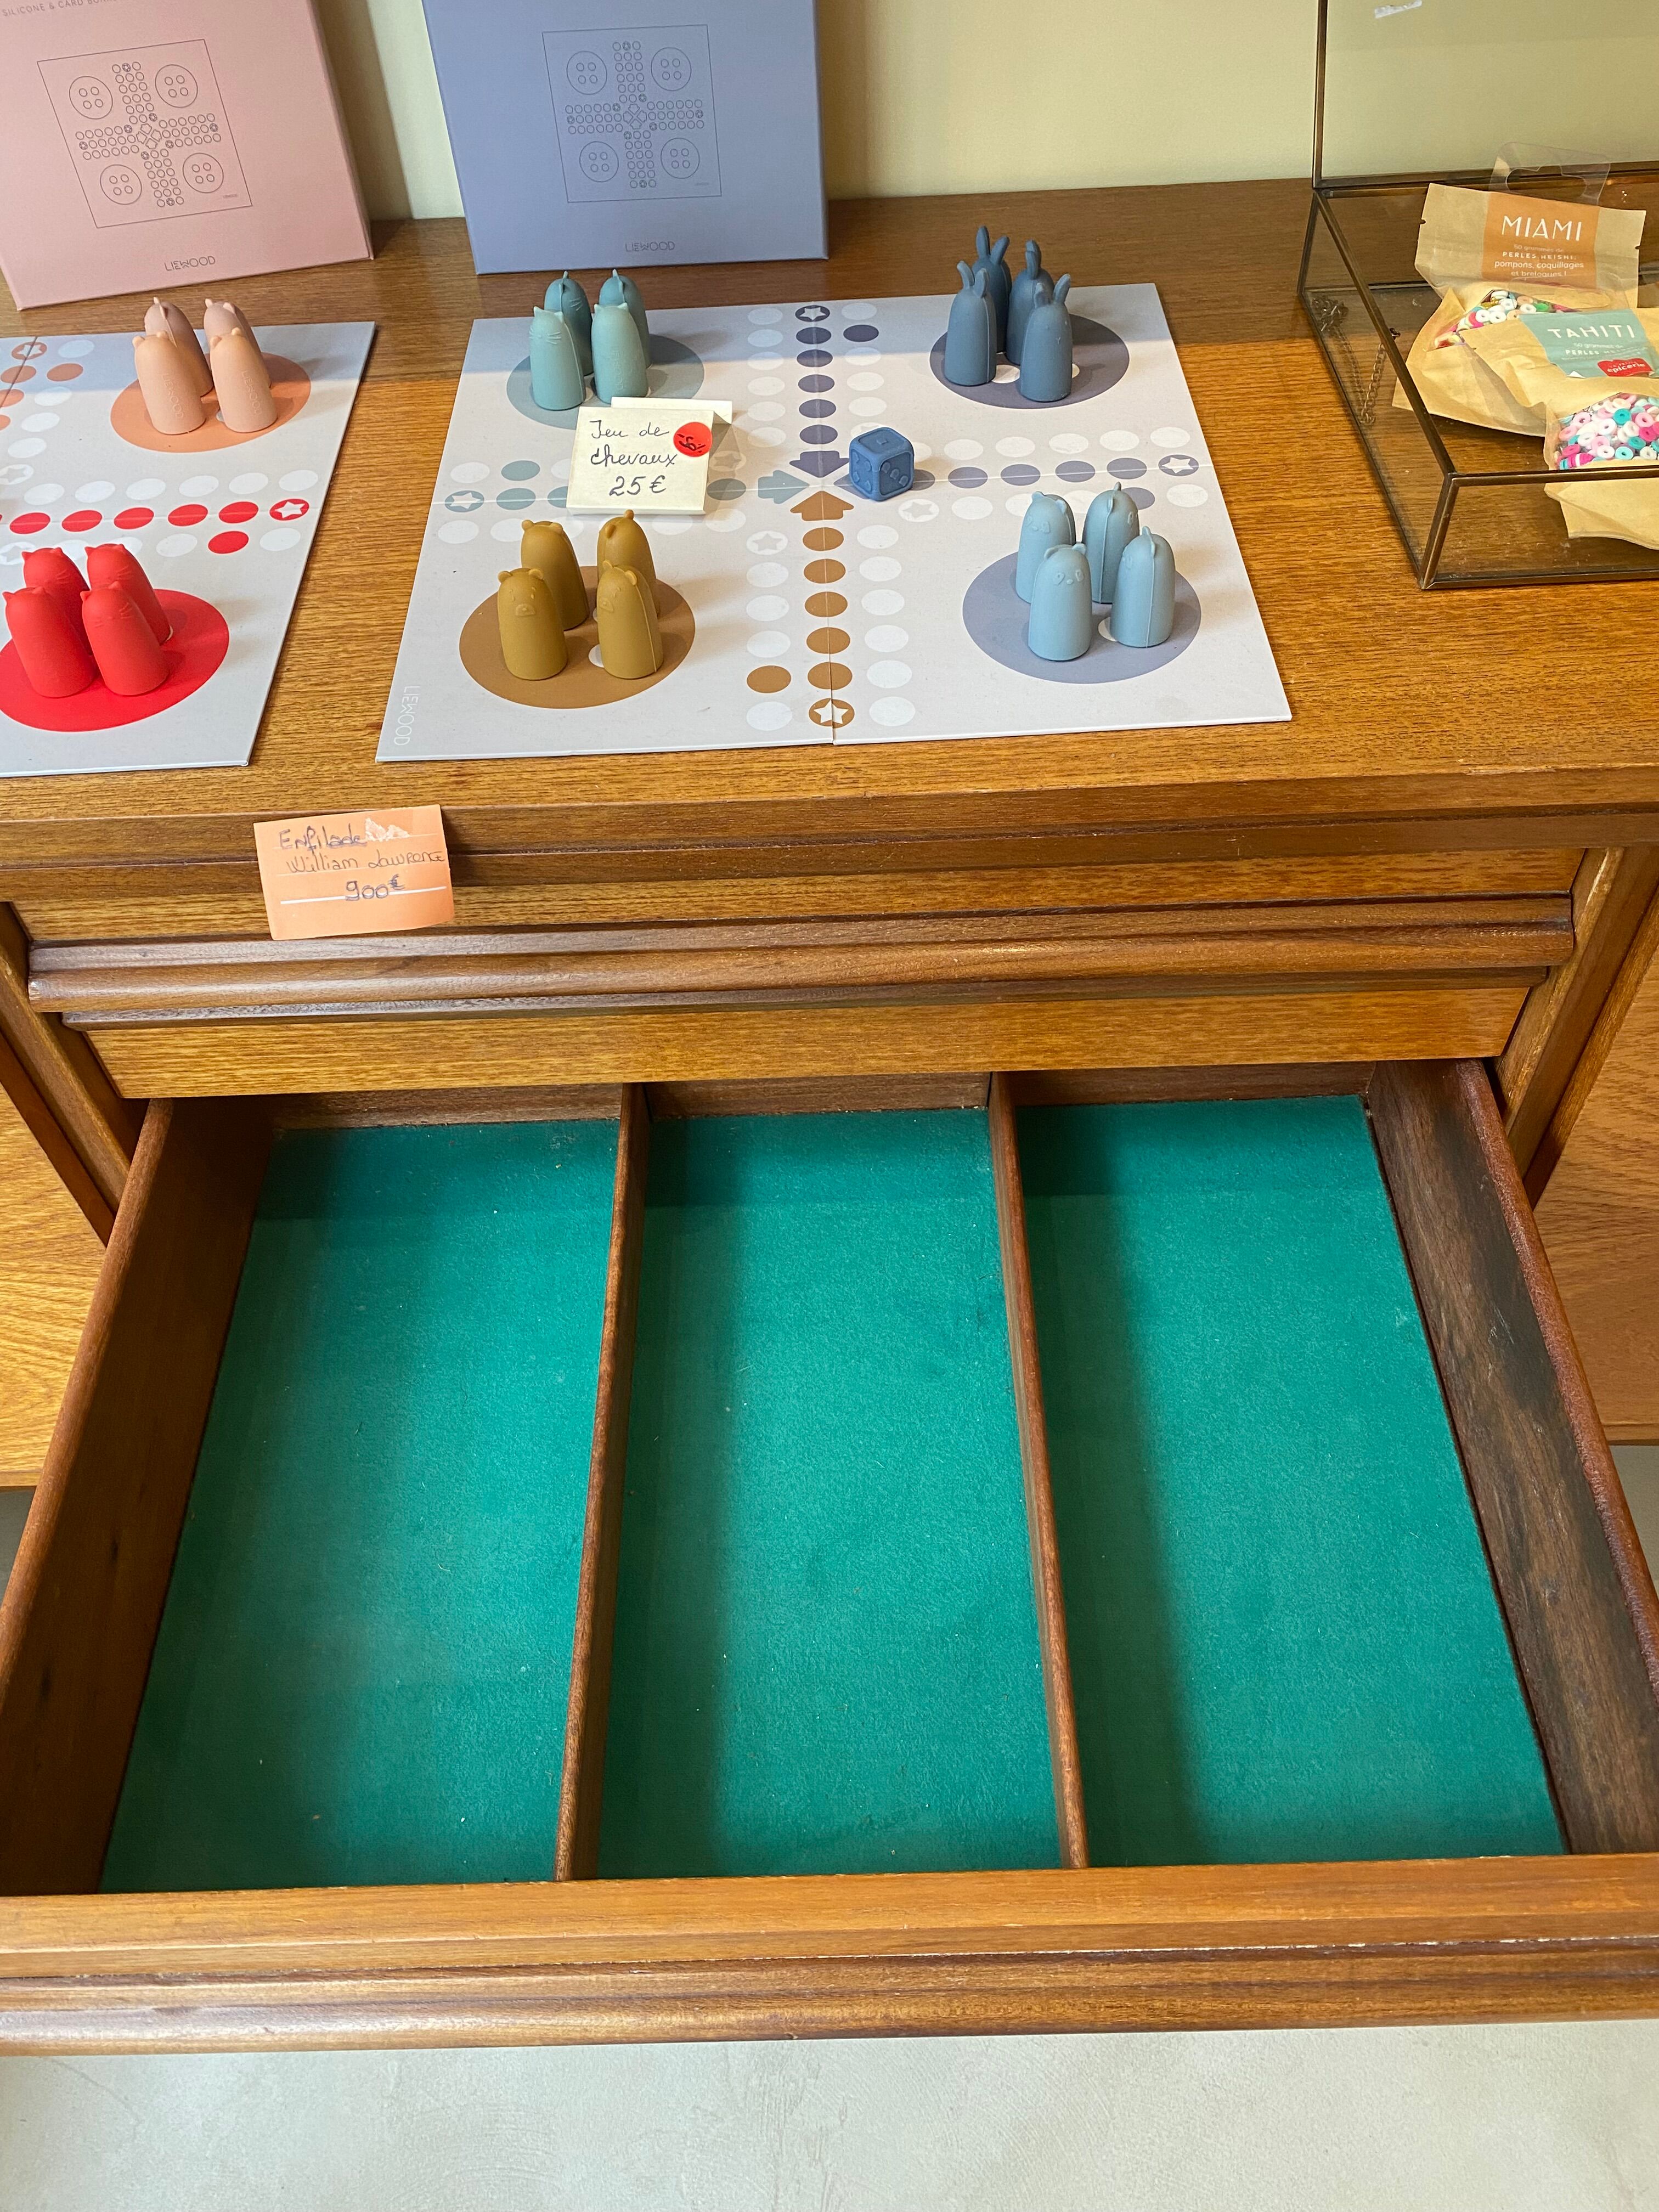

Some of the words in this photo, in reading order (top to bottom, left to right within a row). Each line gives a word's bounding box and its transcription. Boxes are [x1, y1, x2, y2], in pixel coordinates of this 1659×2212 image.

[2, 3, 46, 16] SILICONE
[1501, 215, 1582, 241] MIAMI
[625, 241, 676, 252] LIEWOOD
[164, 255, 216, 272] LIEWOOD
[1494, 261, 1535, 269] pompons,
[1536, 261, 1584, 269] coquillages
[1547, 324, 1635, 338] TAHITI
[161, 373, 184, 418] LIEWOOD
[241, 370, 263, 415] LIEWOOD
[589, 420, 629, 439] Jeu
[639, 422, 670, 437] de
[608, 475, 667, 496] 25€
[393, 686, 421, 746] LIEWOOD
